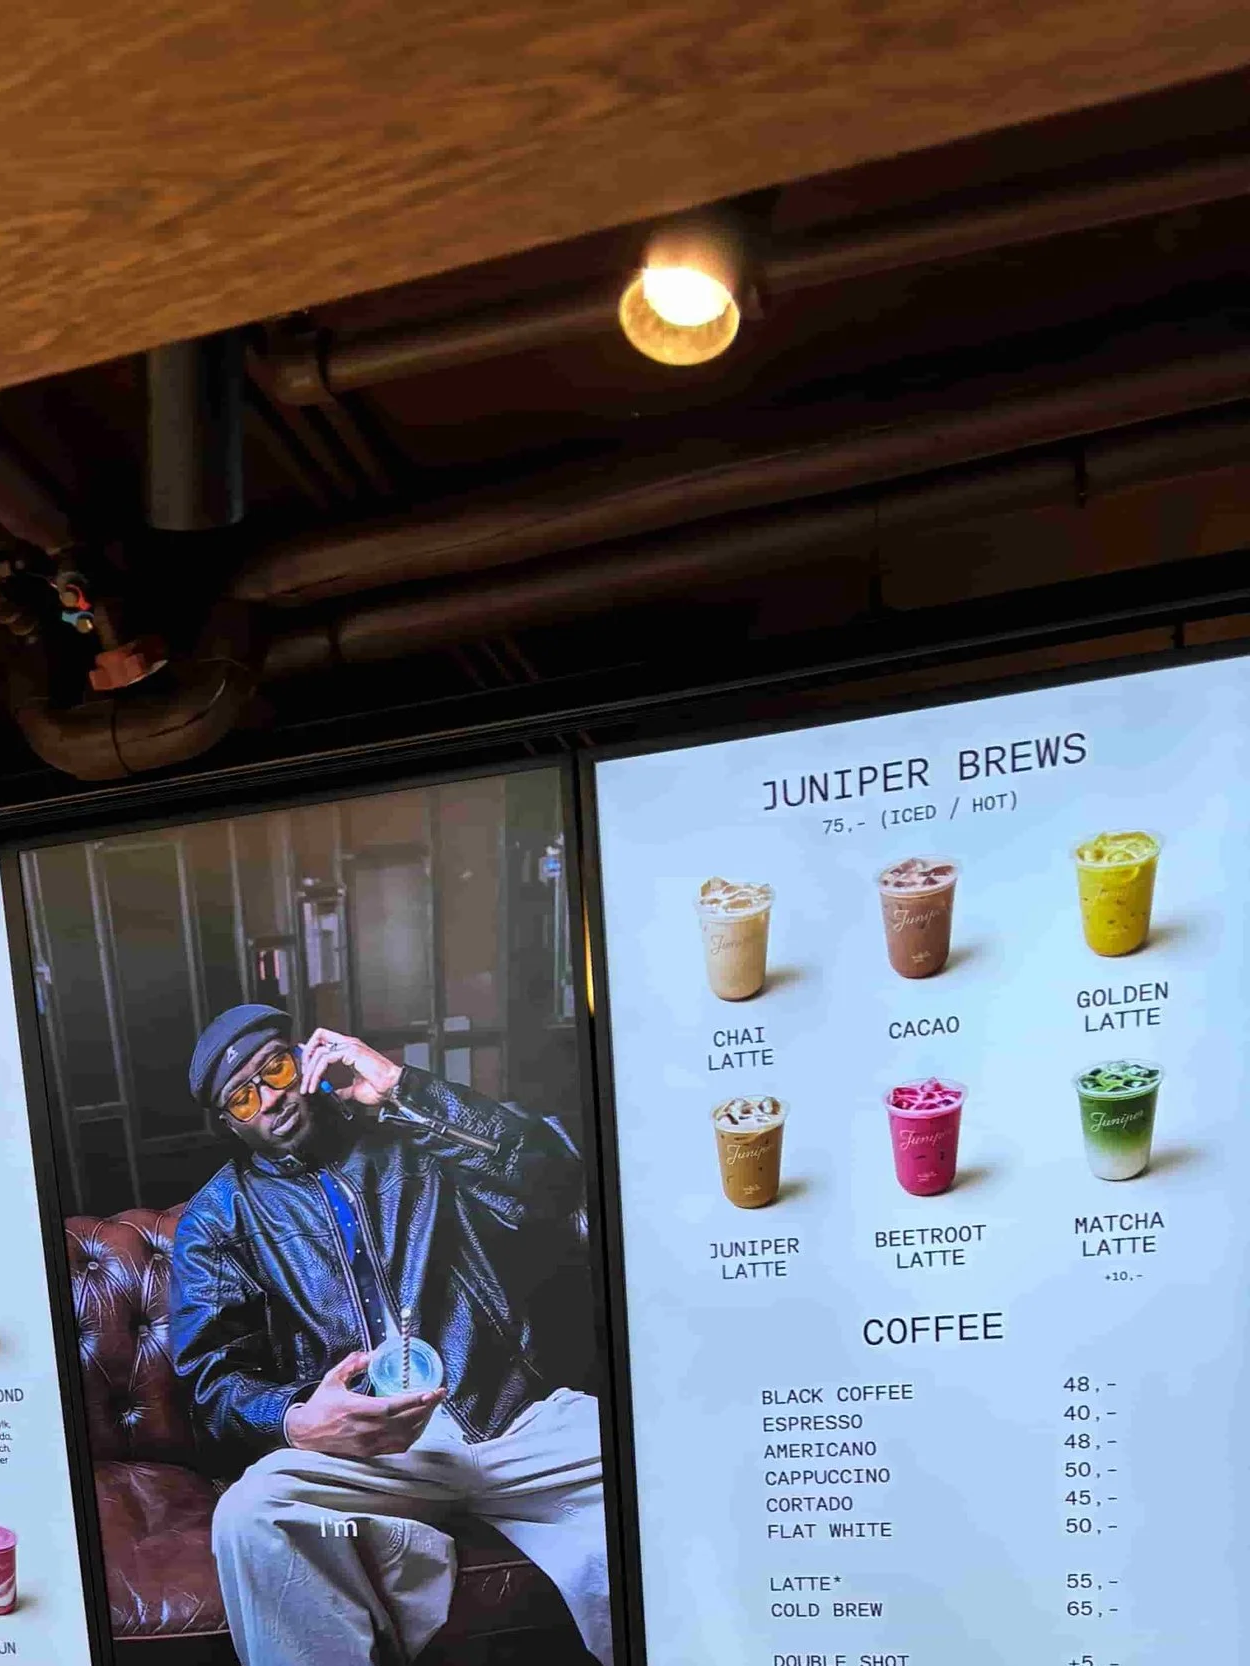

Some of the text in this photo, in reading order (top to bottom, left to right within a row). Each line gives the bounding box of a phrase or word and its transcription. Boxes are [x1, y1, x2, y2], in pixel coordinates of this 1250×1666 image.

[763, 733, 1086, 810] JUNIPER BREWS
[882, 805, 936, 830] (ICED
[972, 791, 1017, 813] HOT)
[1077, 981, 1168, 1008] GOLDEN
[889, 1016, 959, 1039] CACAO
[1085, 1007, 1160, 1032] LATTE
[713, 1027, 765, 1047] CHAI
[708, 1049, 774, 1071] LATTE
[1075, 1212, 1164, 1234] MATCHA
[875, 1225, 986, 1248] BEETROOT
[1083, 1236, 1156, 1257] LATTE
[710, 1238, 799, 1259] JUNIPER
[897, 1249, 965, 1269] LATTE
[722, 1260, 787, 1279] LATTE
[864, 1313, 1003, 1345] COFFEE
[762, 1384, 913, 1405] BLACK COFFEE
[763, 1414, 862, 1432] ESPRESSO
[764, 1441, 877, 1459] AMERICANO
[765, 1468, 890, 1486] CAPPUCCINO
[766, 1496, 853, 1512] CORTADO
[320, 1516, 359, 1539] I'm
[768, 1522, 892, 1538] FLAT WHITE
[771, 1603, 883, 1617] COLD BREW
